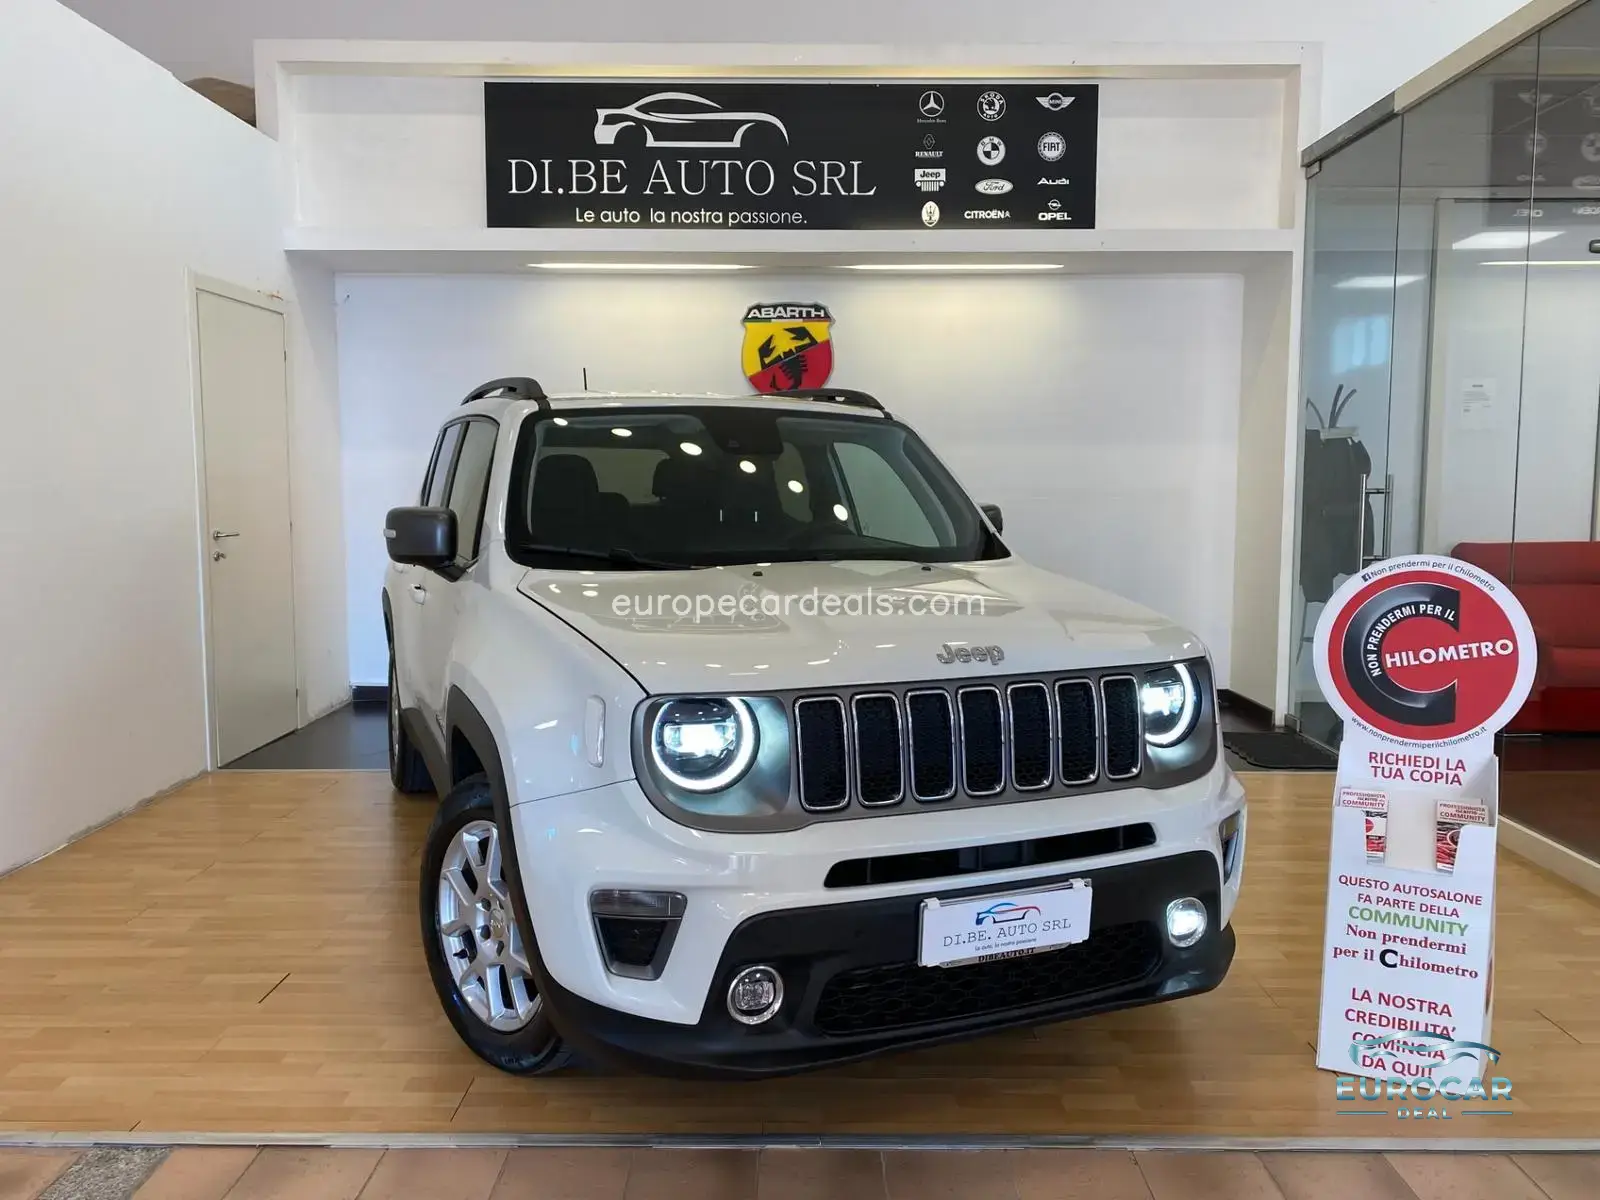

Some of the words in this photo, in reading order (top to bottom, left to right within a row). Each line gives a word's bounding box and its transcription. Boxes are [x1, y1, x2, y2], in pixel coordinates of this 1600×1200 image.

[915, 150, 944, 158] RENAULT
[1043, 142, 1061, 151] FIAT
[508, 159, 627, 196] DI.BE
[643, 159, 775, 196] AUTO
[792, 160, 877, 197] SRL
[920, 170, 941, 180] Jeep
[1037, 177, 1070, 185] Audi
[983, 181, 1006, 192] Ford
[575, 207, 596, 223] Le
[600, 208, 641, 224] auto
[650, 207, 667, 223] la
[671, 209, 723, 224] nostra
[728, 208, 808, 227] passione.
[1038, 212, 1072, 221] OPEL
[748, 306, 825, 318] ABARTH
[1371, 567, 1387, 577] Non
[1388, 560, 1430, 572] prendermi
[1455, 565, 1496, 592] Chilometro
[1420, 604, 1443, 616] PER
[1444, 609, 1456, 622] IL
[1367, 605, 1415, 651] PRENDERMI
[936, 643, 1005, 666] Jeep
[1366, 654, 1382, 677] NON
[1369, 751, 1440, 770] RICHIEDI
[1446, 758, 1467, 773] LA
[1371, 765, 1405, 781] TUA
[1409, 771, 1463, 787] COPIA
[1342, 799, 1386, 809] COMMUNITY
[1439, 811, 1486, 822] COMMUNITY
[1338, 874, 1390, 892] QUESTO
[1393, 883, 1483, 906] AUTOSALONE
[1357, 893, 1374, 905] FA
[1376, 896, 1416, 911] PARTE
[1419, 904, 1460, 918] DELLA
[1349, 906, 1469, 937] COMMUNITY
[943, 930, 992, 947] DI.BE.
[997, 922, 1038, 939] AUTO
[1042, 918, 1072, 932] SRL
[1346, 924, 1377, 941] Non
[1382, 932, 1467, 955] prendermi
[978, 947, 1037, 962] DIBEAUTO.IT
[1333, 946, 1359, 960] per
[1364, 949, 1375, 961] il
[1379, 948, 1479, 980] Chilometro
[1351, 987, 1373, 1004] LA
[1378, 992, 1453, 1018] NOSTRA
[1361, 1055, 1387, 1071] DA
